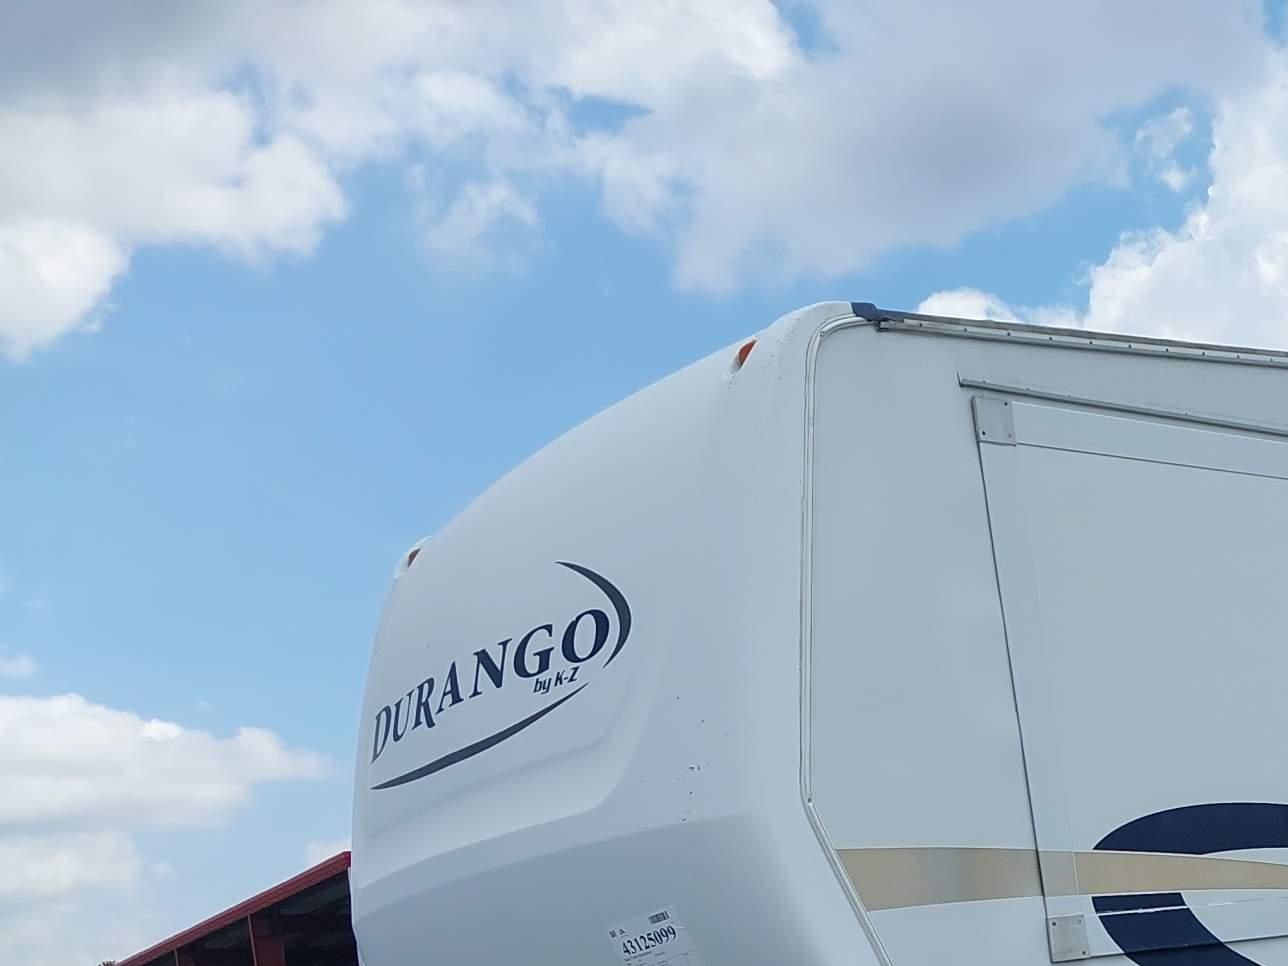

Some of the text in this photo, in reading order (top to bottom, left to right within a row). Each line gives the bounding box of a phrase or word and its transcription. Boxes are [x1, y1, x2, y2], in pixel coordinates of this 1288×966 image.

[371, 609, 610, 763] DURANGO
[533, 666, 579, 695] by K-Z
[623, 926, 676, 955] 43125099
